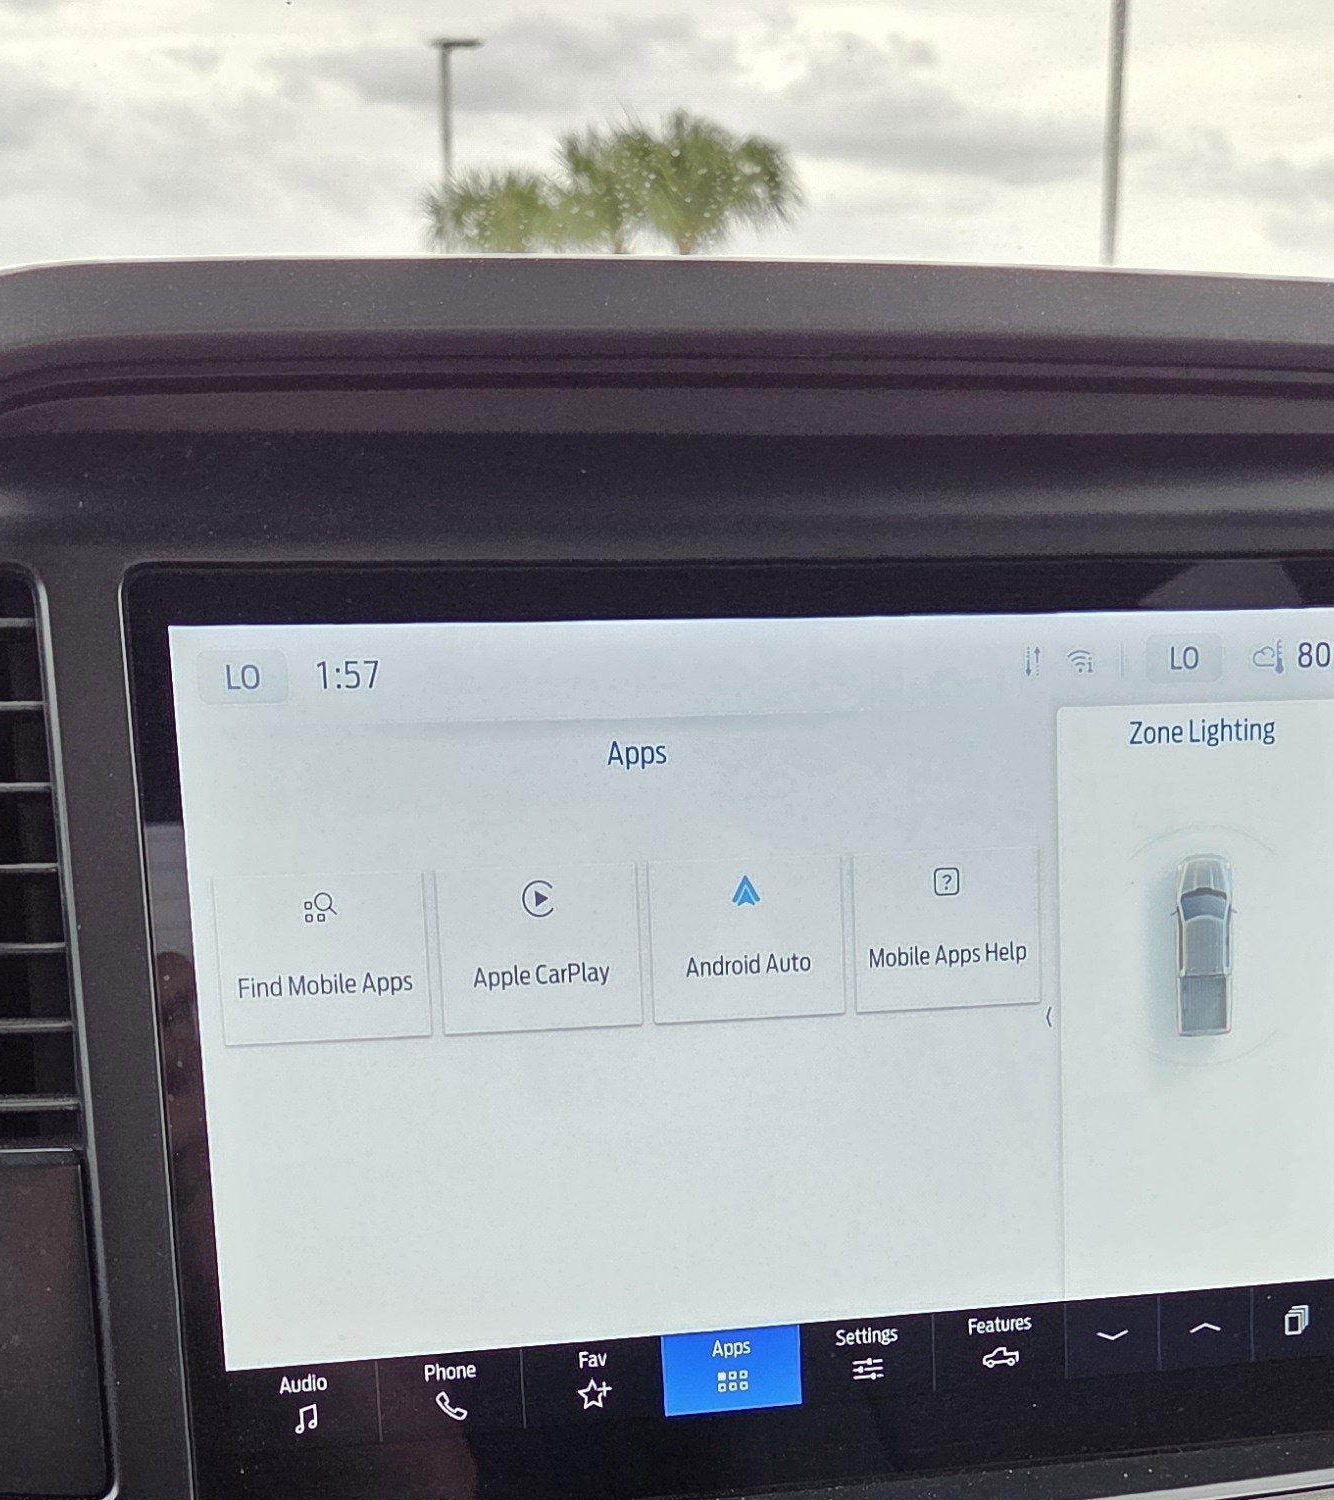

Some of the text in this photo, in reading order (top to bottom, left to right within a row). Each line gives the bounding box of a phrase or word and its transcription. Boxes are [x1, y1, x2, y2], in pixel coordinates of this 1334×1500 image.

[1170, 646, 1200, 671] LO
[225, 663, 261, 691] LO
[315, 660, 381, 691] 1:57
[1129, 718, 1276, 747] Zone Lighting
[606, 740, 668, 770] Apps
[685, 951, 812, 979] Android Auto
[868, 940, 1028, 969] Mobile Apps Help
[238, 971, 413, 999] Find Mobile Apps
[472, 961, 611, 989] Apple CarPlay
[835, 1324, 899, 1346] Settings
[968, 1314, 1033, 1336] Features
[578, 1349, 608, 1369] Fav
[711, 1338, 752, 1359] Apps
[279, 1373, 328, 1395] Audio
[423, 1362, 477, 1382] Phone
